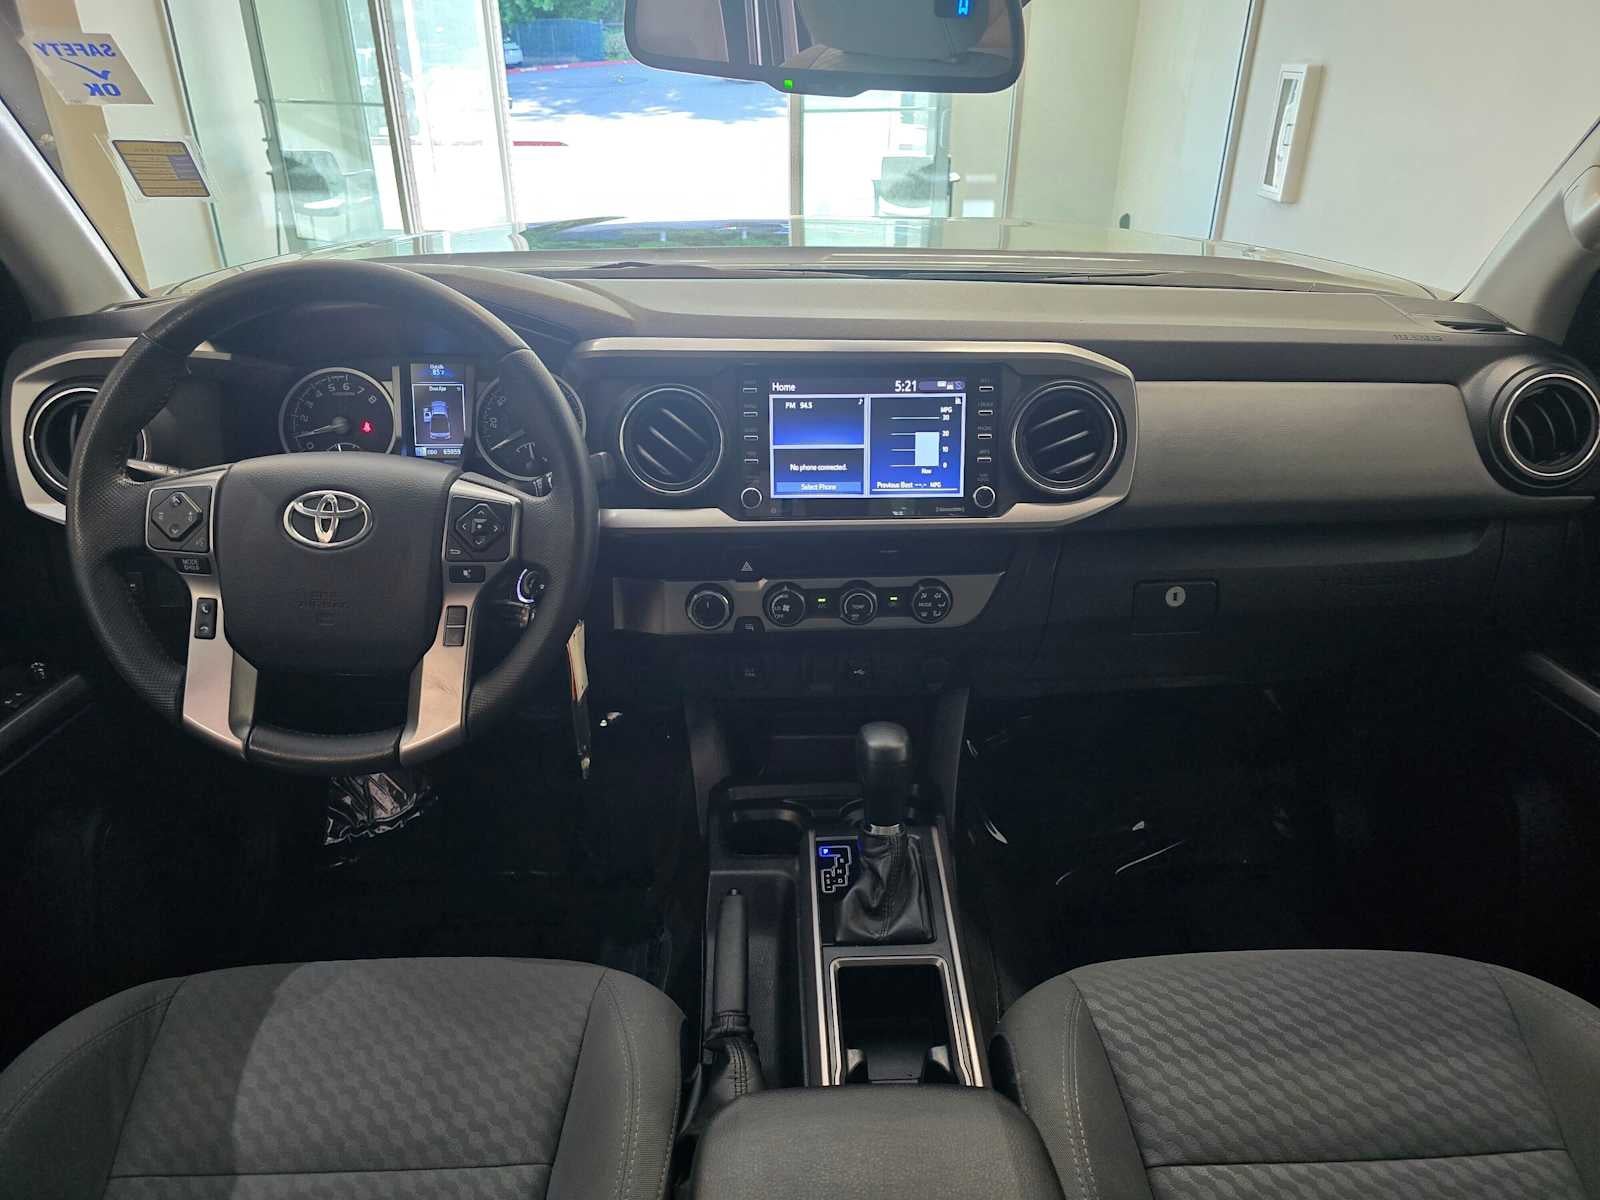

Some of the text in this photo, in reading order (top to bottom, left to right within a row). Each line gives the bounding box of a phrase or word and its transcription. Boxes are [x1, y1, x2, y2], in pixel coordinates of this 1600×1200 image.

[772, 382, 796, 392] Home
[894, 380, 917, 392] 5:21
[800, 464, 817, 472] phone
[877, 481, 900, 489] Previous
